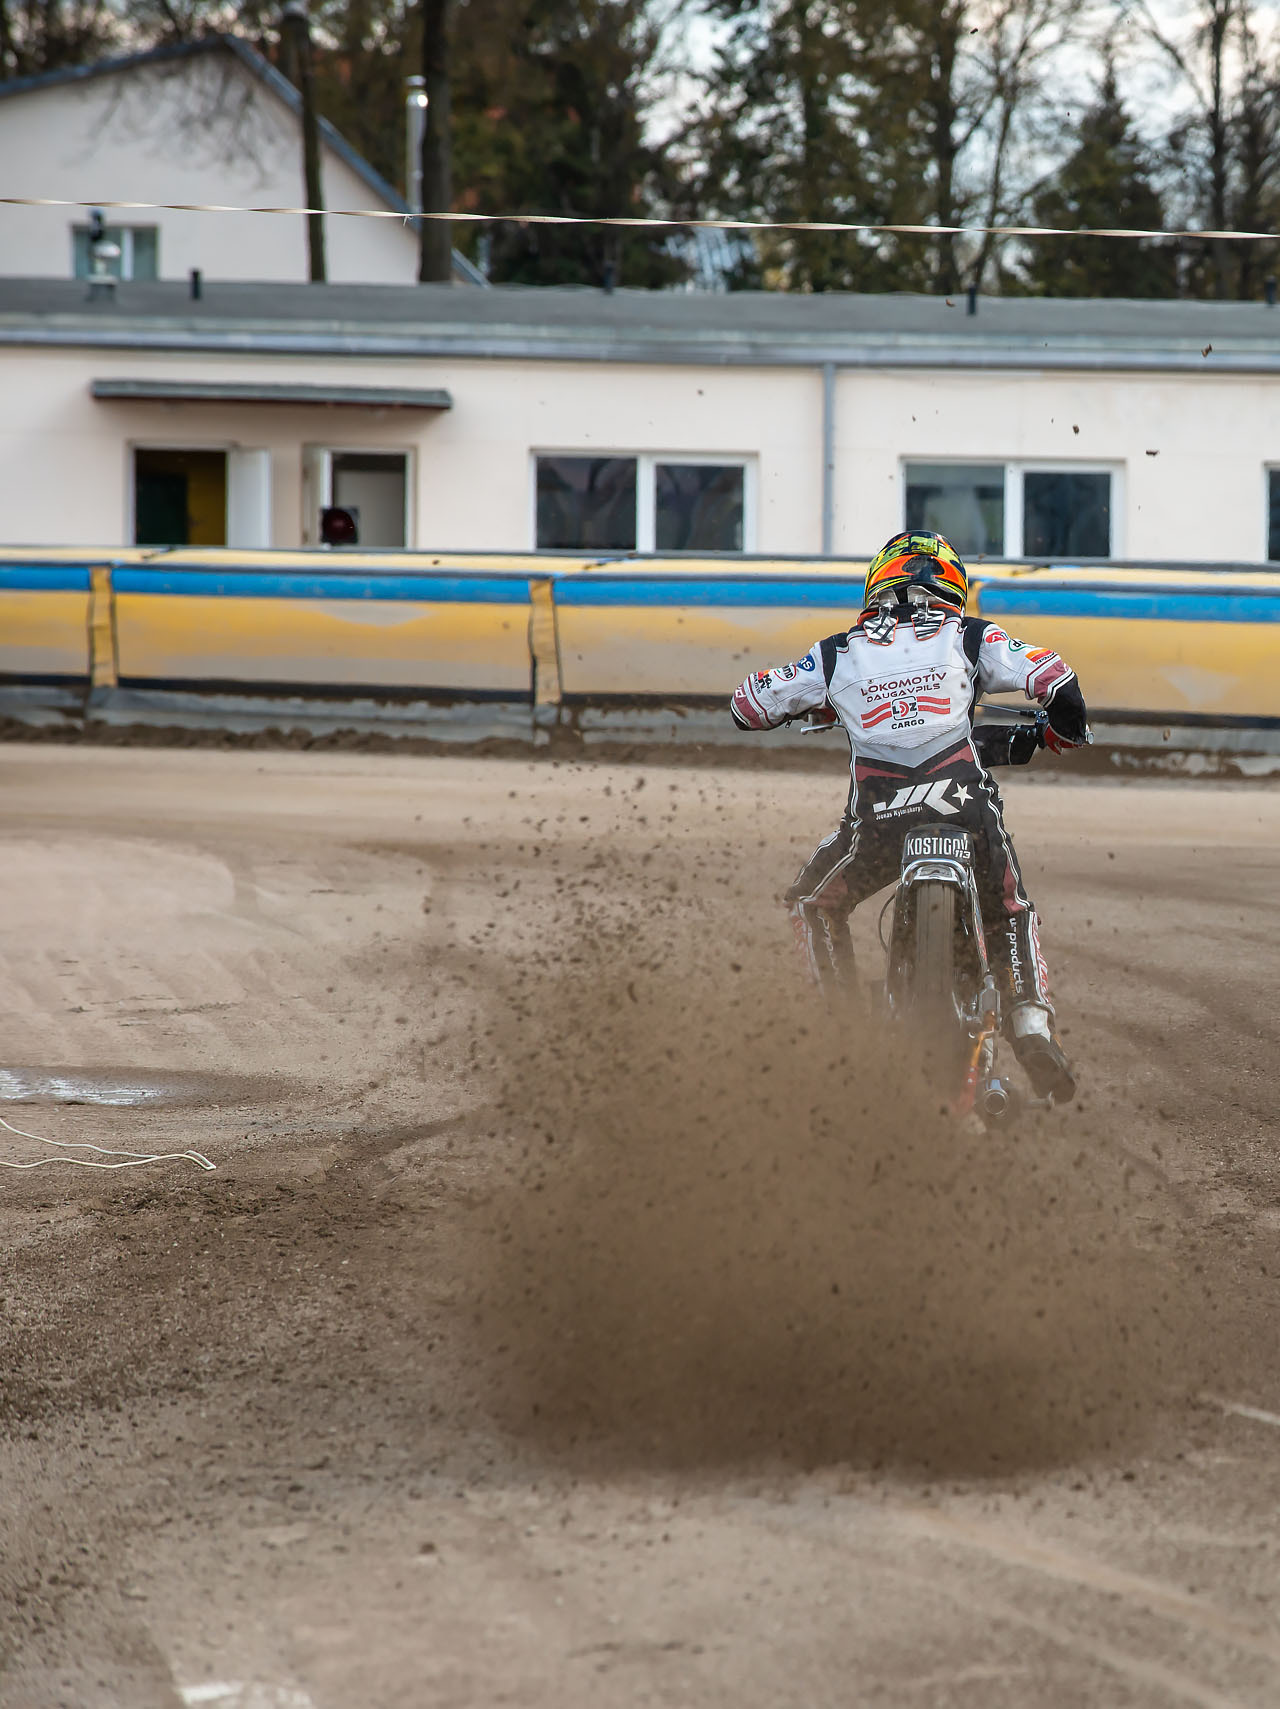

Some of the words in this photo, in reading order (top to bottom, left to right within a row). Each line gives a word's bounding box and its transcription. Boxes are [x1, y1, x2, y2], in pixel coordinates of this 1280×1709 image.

[861, 672, 947, 697] LOKOMOTIV
[866, 683, 941, 703] DAUGAVPILS
[891, 718, 925, 730] CARGO
[907, 836, 969, 856] KOSTIGOV
[954, 849, 971, 860] 113
